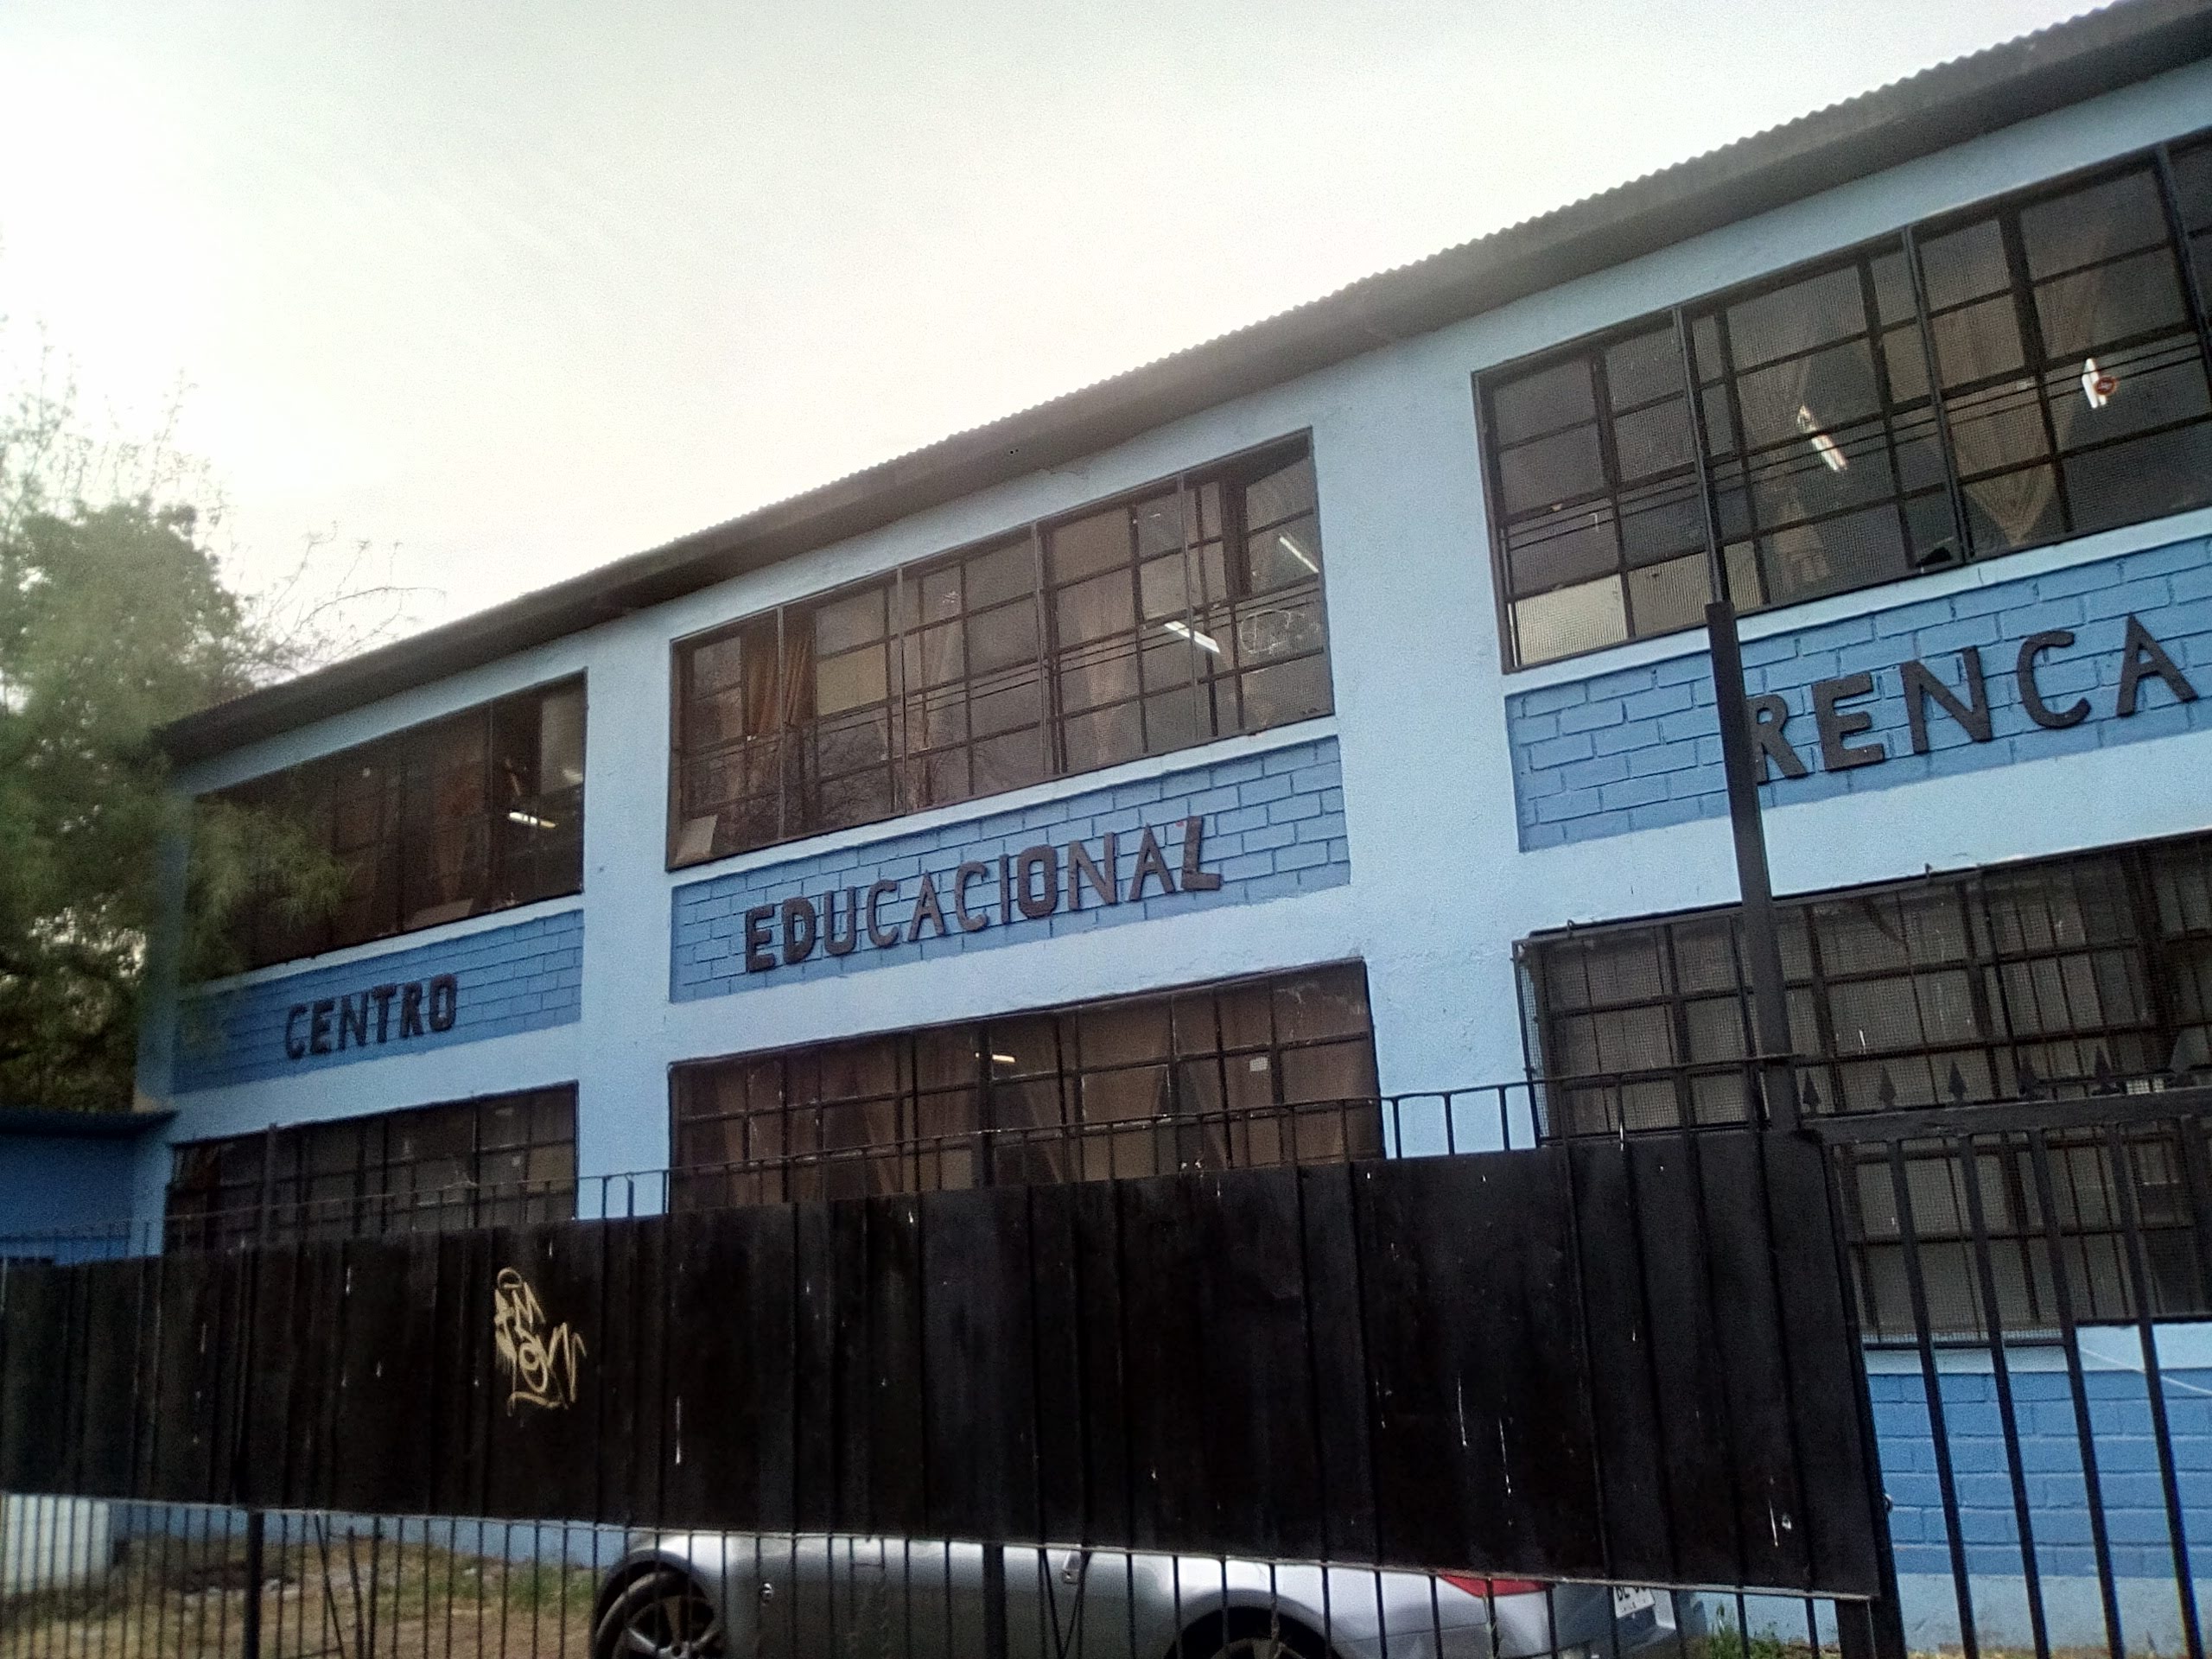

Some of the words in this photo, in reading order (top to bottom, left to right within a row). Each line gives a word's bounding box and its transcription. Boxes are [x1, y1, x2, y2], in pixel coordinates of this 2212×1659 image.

[285, 973, 458, 1060] CENTRO
[746, 815, 1222, 974] EDUCACIONAL
[1745, 611, 2199, 785] RENCA
